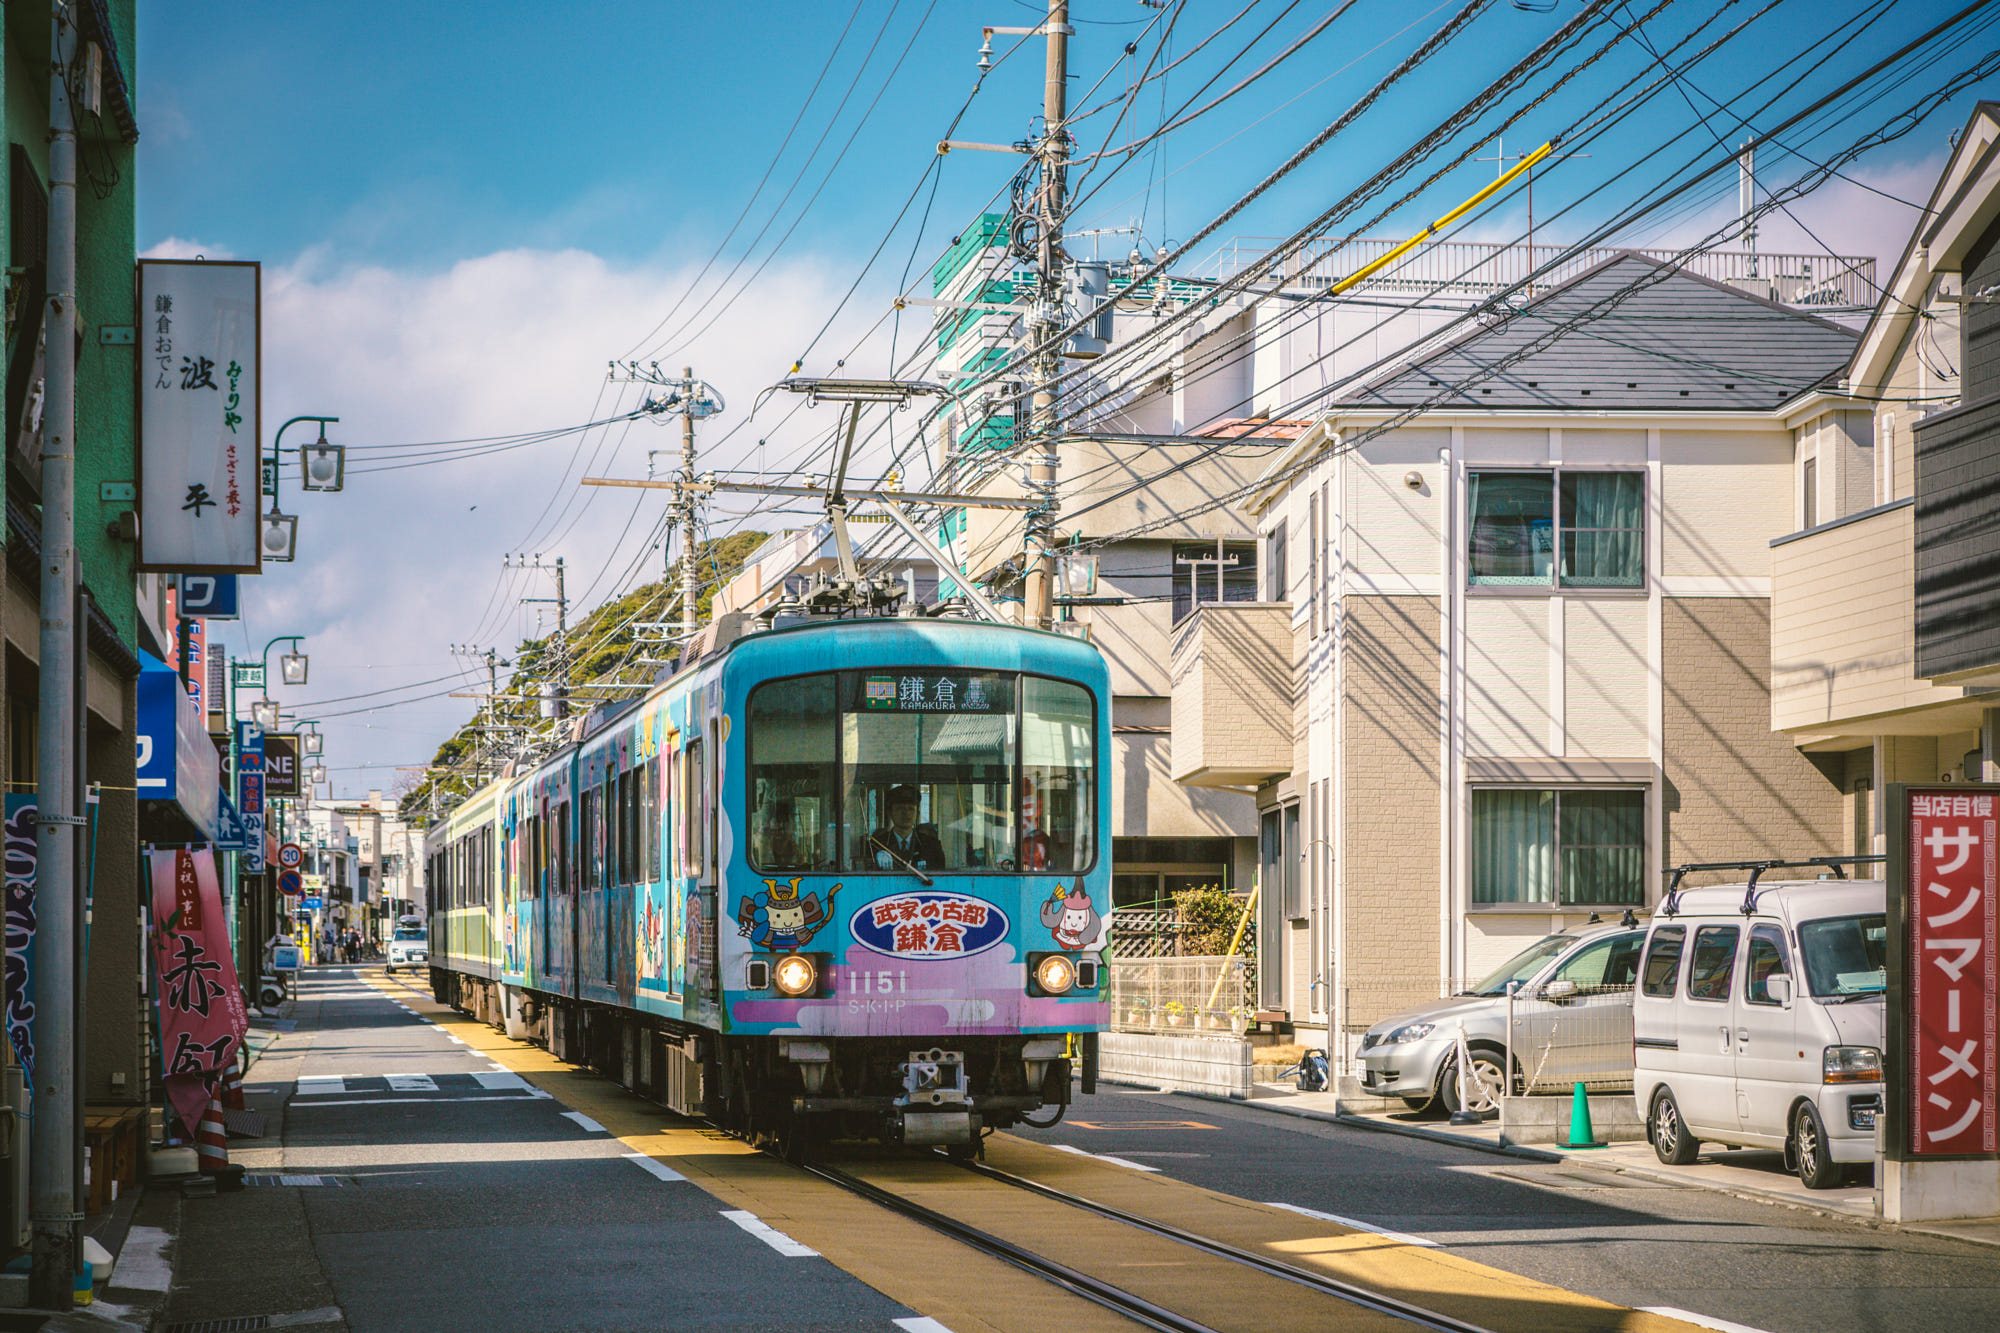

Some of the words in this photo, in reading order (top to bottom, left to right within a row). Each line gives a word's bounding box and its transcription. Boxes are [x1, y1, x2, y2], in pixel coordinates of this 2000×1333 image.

[155, 294, 173, 390] 鎌倉おでん
[224, 360, 242, 434] みどりや
[180, 356, 218, 518] 波平
[899, 676, 957, 701] 鎌倉
[900, 701, 956, 710] KAMAKURA
[242, 724, 262, 747] P
[1912, 795, 1992, 818] 当店自慢
[283, 850, 298, 862] 30
[179, 857, 195, 926] お祝い事に
[874, 902, 987, 926] 武家の古都
[896, 924, 963, 952] 鎌倉
[850, 971, 906, 994] 1151
[1922, 826, 1983, 1143] サンマーメン
